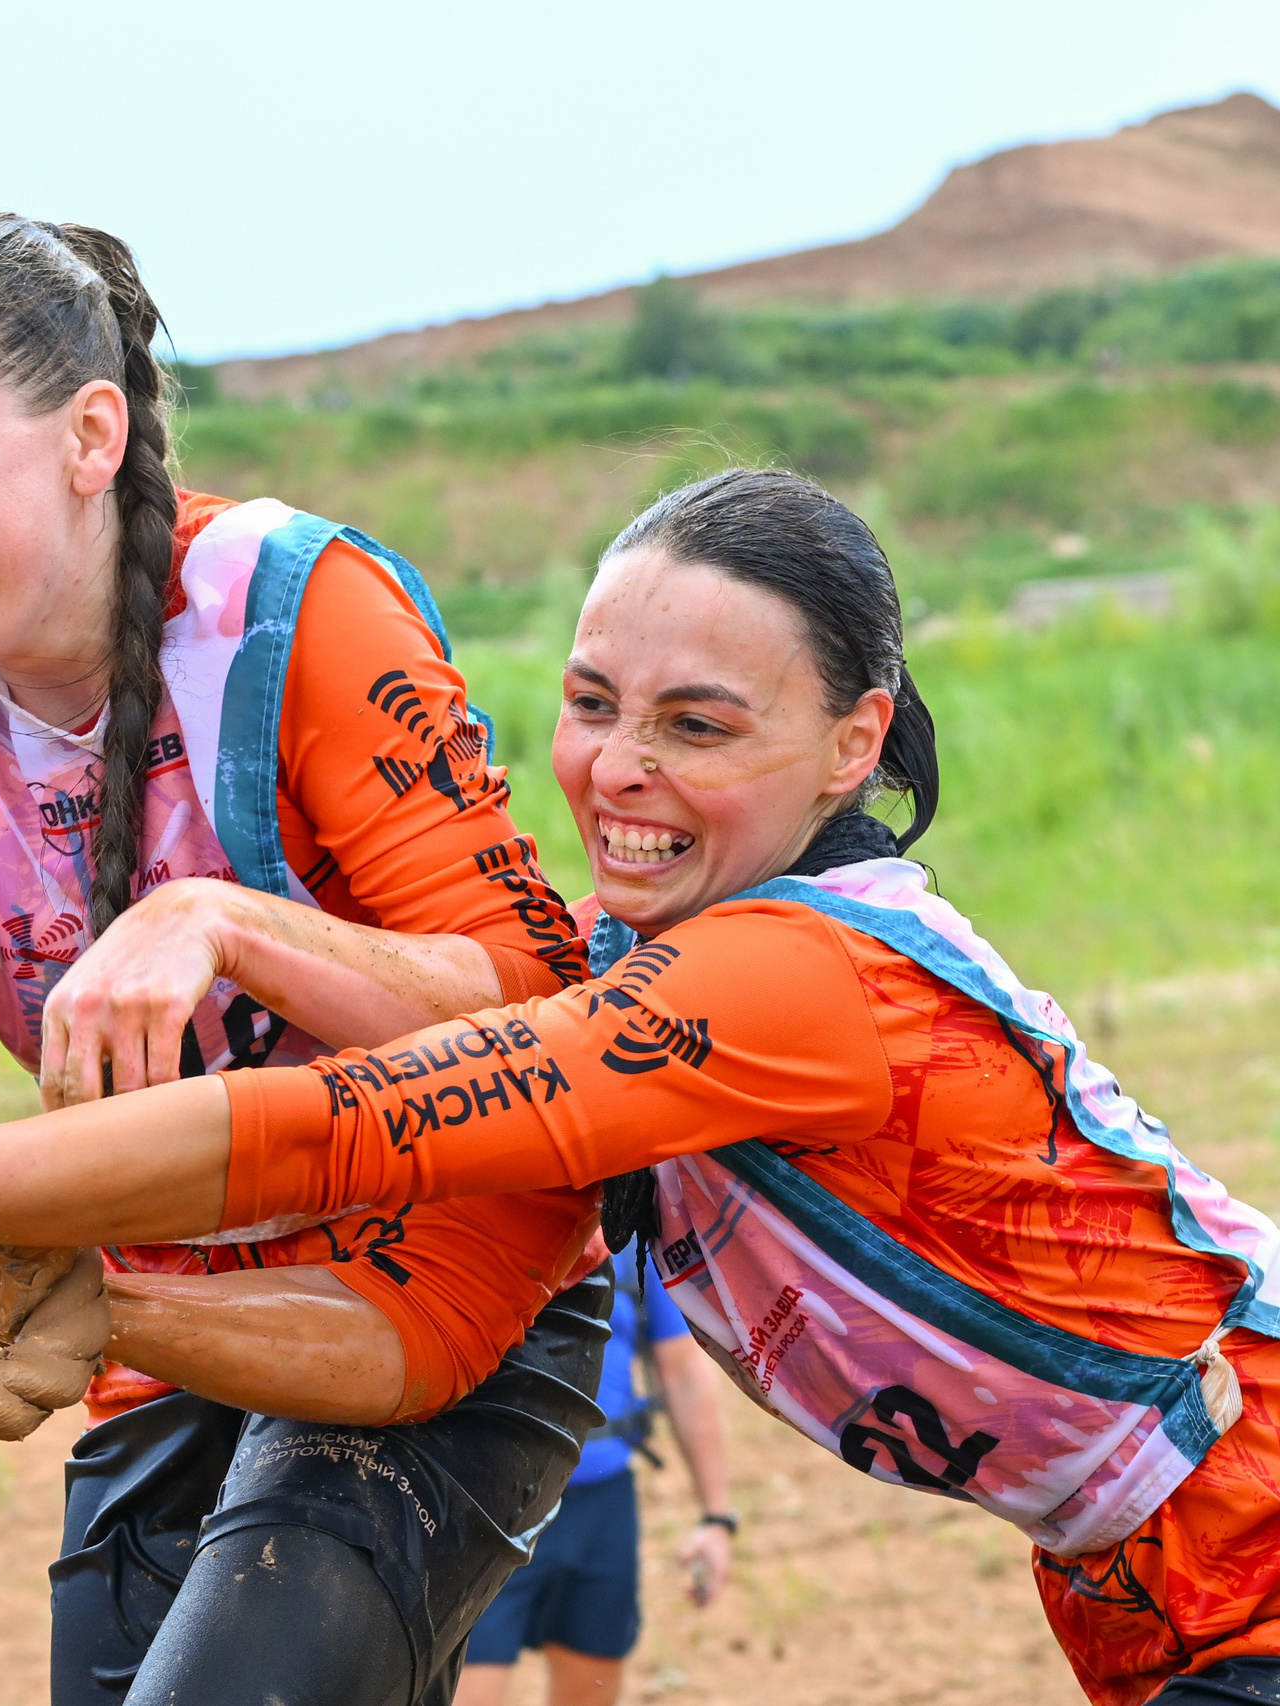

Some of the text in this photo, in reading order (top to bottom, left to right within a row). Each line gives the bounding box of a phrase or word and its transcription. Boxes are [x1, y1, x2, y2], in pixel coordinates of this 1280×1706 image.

[259, 1432, 381, 1455] КАЗАНСКИЙ
[839, 1385, 1000, 1491] 22
[253, 1445, 397, 1482] ВЕРТОЛЕТНЫЙ
